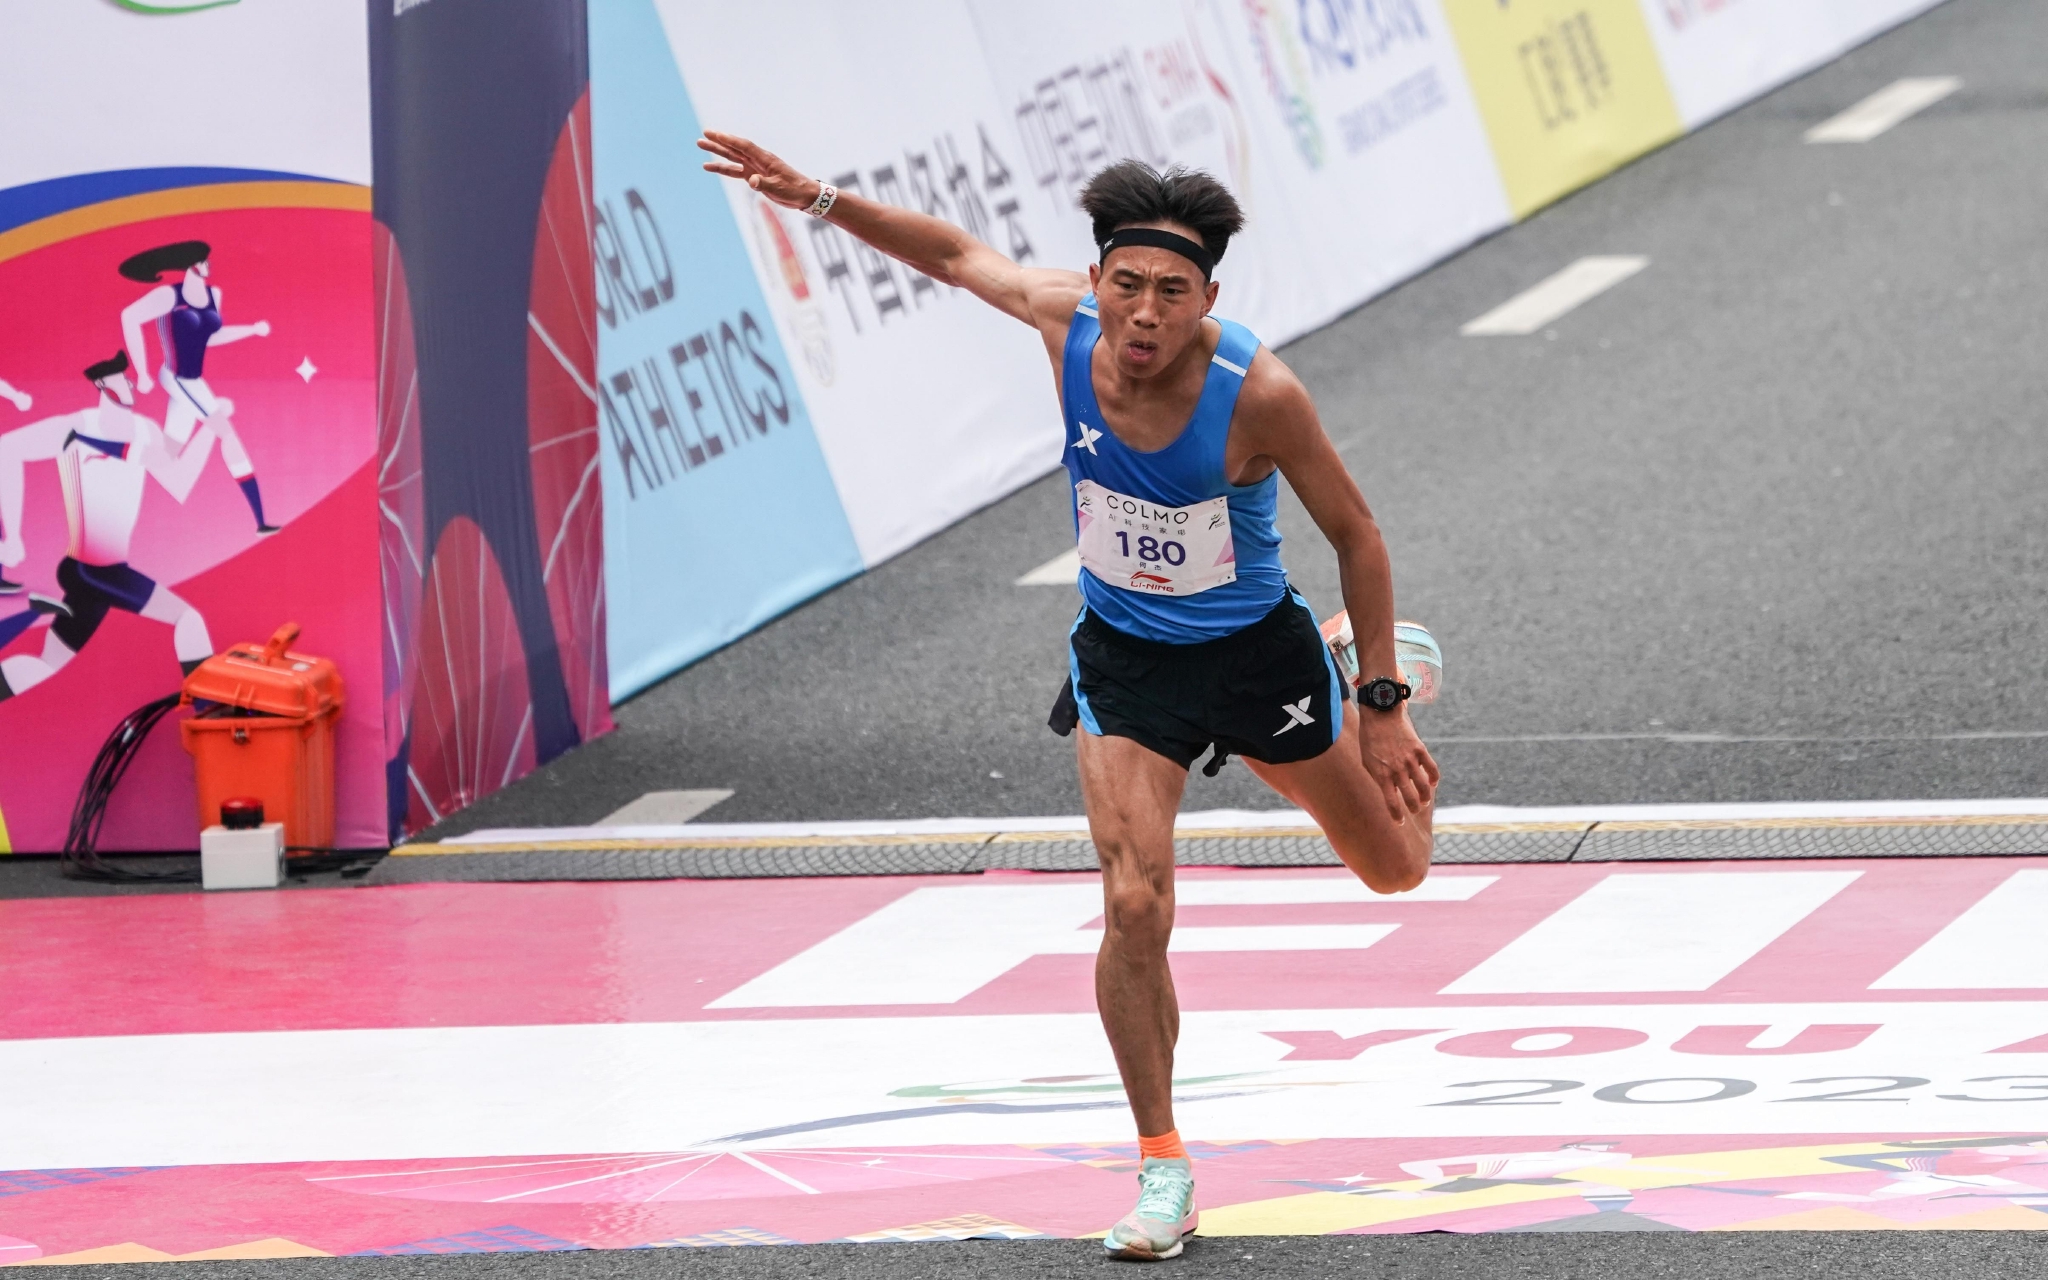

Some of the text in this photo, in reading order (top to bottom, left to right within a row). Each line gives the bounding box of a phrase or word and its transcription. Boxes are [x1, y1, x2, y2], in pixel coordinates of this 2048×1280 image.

[594, 188, 674, 330] ORLD
[599, 309, 789, 500] ATHLETICS
[1106, 495, 1189, 525] COLMO
[1115, 530, 1186, 567] 180
[1257, 1023, 1885, 1062] YOU
[1418, 1074, 2048, 1107] 2023
